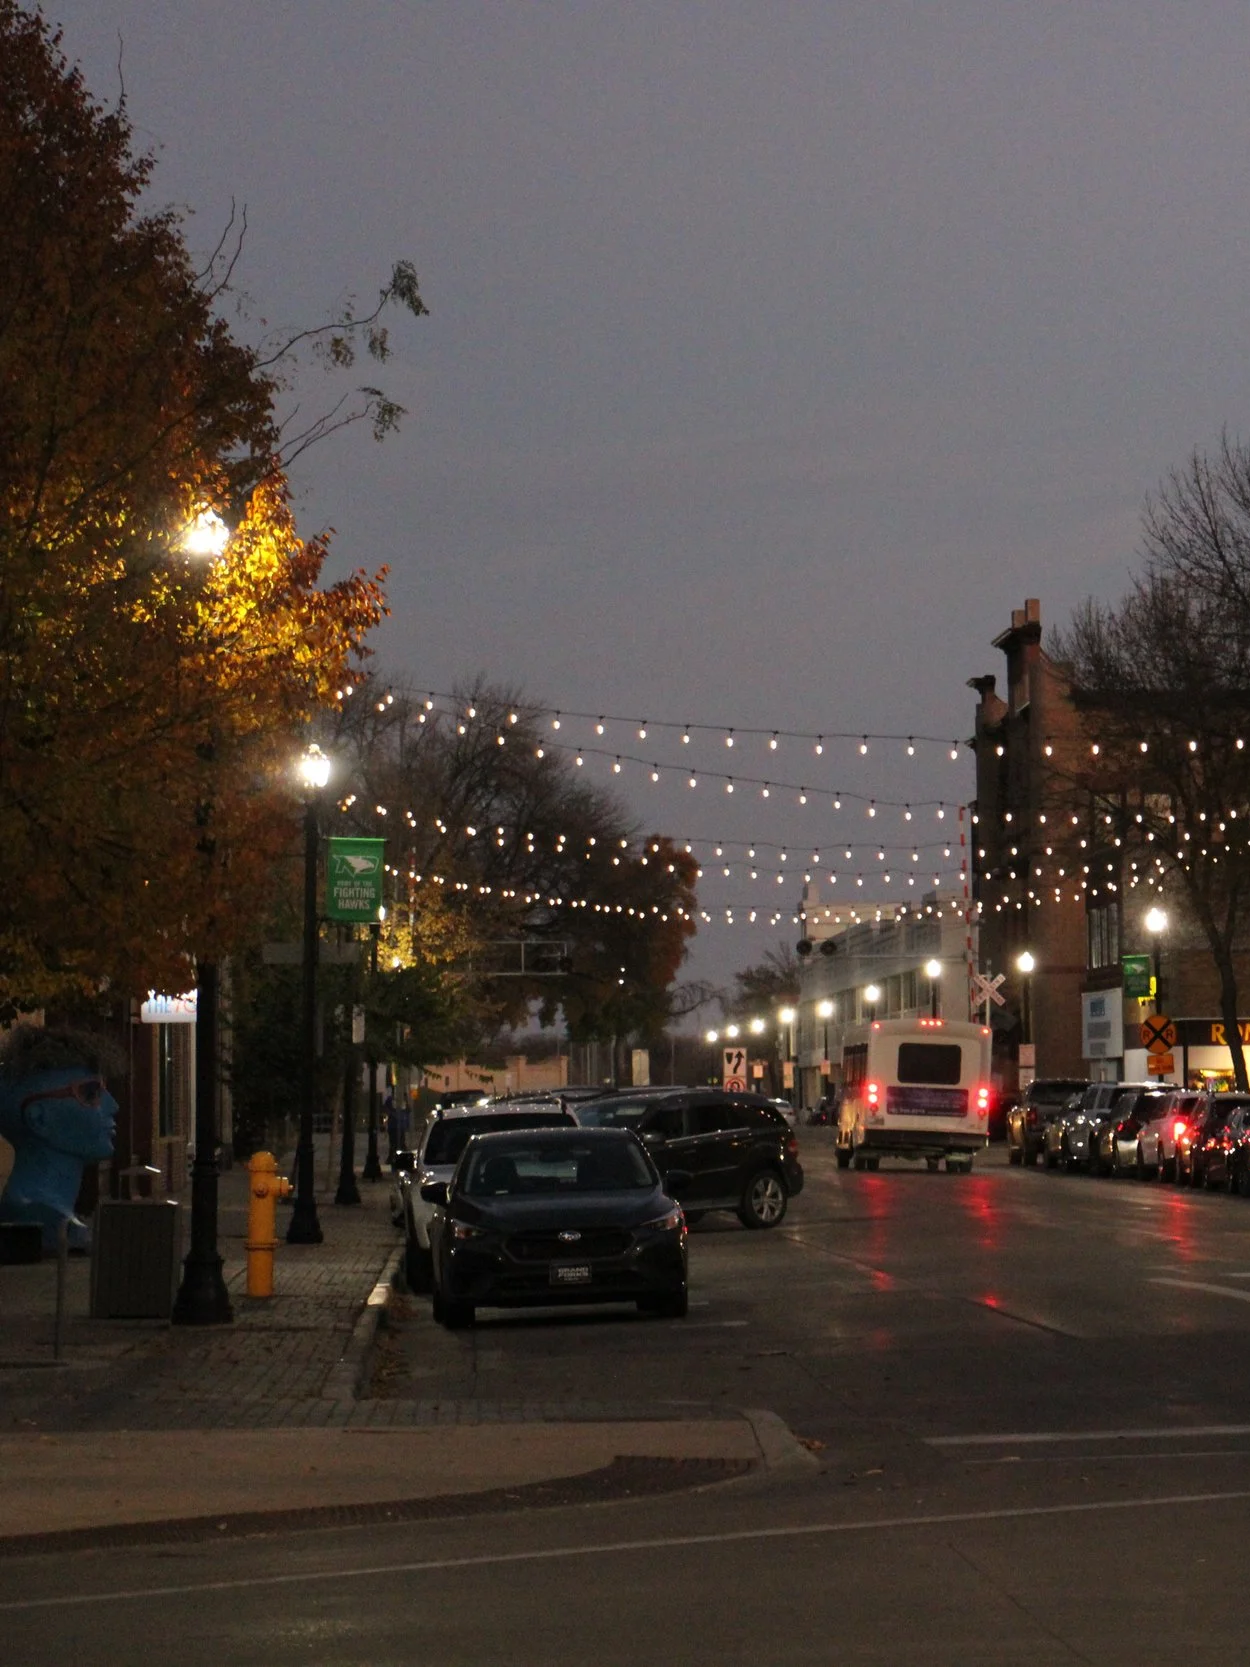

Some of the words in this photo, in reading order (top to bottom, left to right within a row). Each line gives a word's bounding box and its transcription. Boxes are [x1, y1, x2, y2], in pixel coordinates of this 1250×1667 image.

[333, 887, 376, 898] FIGHTING
[338, 899, 370, 910] HAWKS
[1143, 1030, 1151, 1041] R
[1166, 1029, 1174, 1040] R
